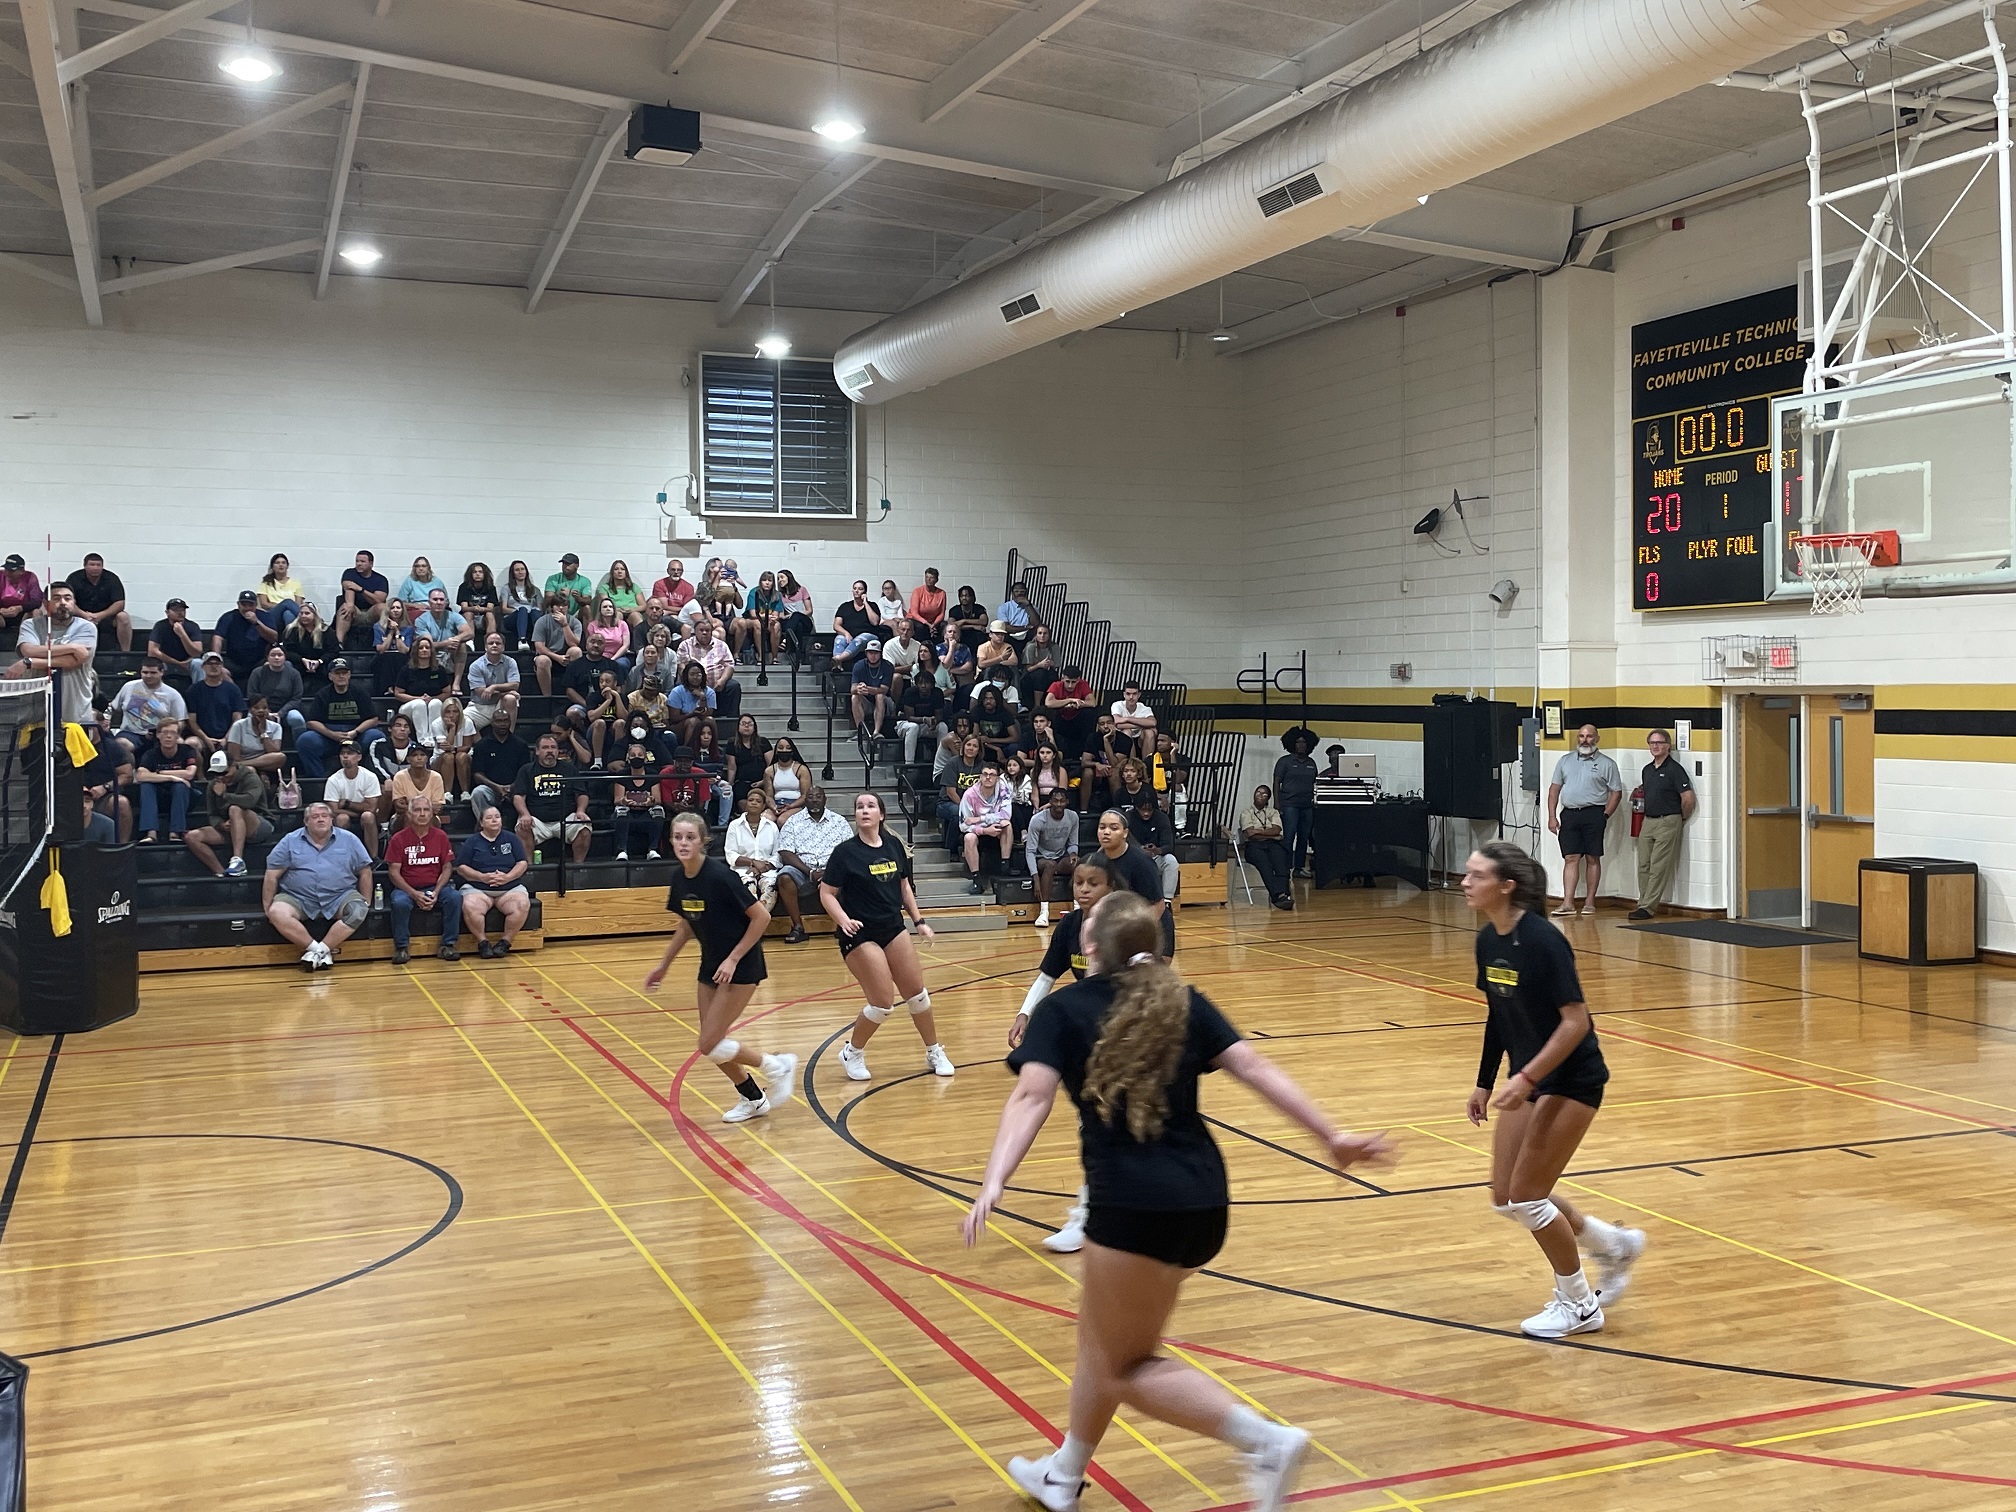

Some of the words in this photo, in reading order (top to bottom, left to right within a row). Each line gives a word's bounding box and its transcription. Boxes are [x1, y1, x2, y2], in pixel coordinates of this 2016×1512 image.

[1633, 332, 1732, 368] FAYETTEVILLE
[1736, 317, 1799, 344] TECHNIC
[1646, 360, 1730, 391] COMMUNITY
[1734, 344, 1806, 372] COLLEGE
[1756, 449, 1798, 473] GUST
[1653, 467, 1685, 489] HOME
[1705, 470, 1739, 487] PERIOD
[1647, 492, 1682, 534] 20
[1723, 493, 1729, 519] 1
[1638, 545, 1661, 565] FLS
[1688, 539, 1719, 560] PLYR
[1726, 534, 1758, 557] FOUL
[1645, 572, 1660, 602] 0
[1771, 647, 1792, 666] EXIT
[408, 857, 440, 865] EXAMPLE
[97, 900, 130, 923] SPALDING
